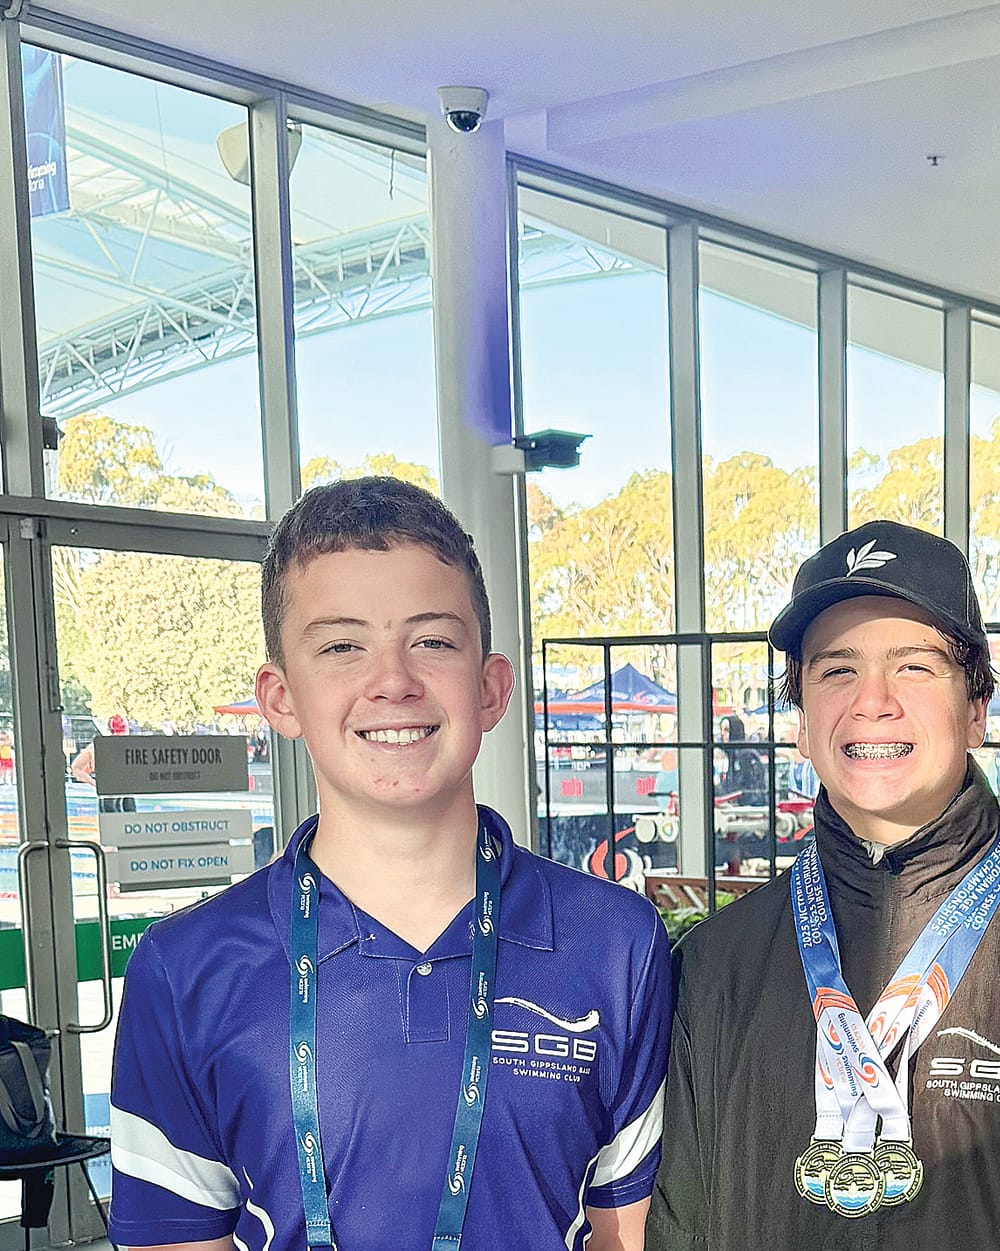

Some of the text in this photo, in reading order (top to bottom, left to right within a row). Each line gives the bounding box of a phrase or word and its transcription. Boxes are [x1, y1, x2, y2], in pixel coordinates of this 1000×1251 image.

[125, 747, 222, 766] FIRE SAFETY DOOR
[124, 820, 229, 835] DO NOT OBSTRUCT
[130, 855, 229, 872] DO NOT FIX OPEN
[814, 884, 828, 922] COURSE
[931, 859, 994, 931] CHAMPIONSHIPS
[960, 893, 979, 912] AGE
[971, 893, 997, 931] COURSE
[937, 910, 963, 937] LONG
[837, 1012, 860, 1054] swimming
[491, 1029, 597, 1062] SGB
[492, 1056, 526, 1066] SOUTH
[530, 1060, 577, 1073] GIPPSLAND
[513, 1068, 561, 1080] SWIMMING
[842, 1055, 858, 1097] swimming
[926, 1079, 958, 1089] SOUTH
[943, 1088, 994, 1102] SWIMMING
